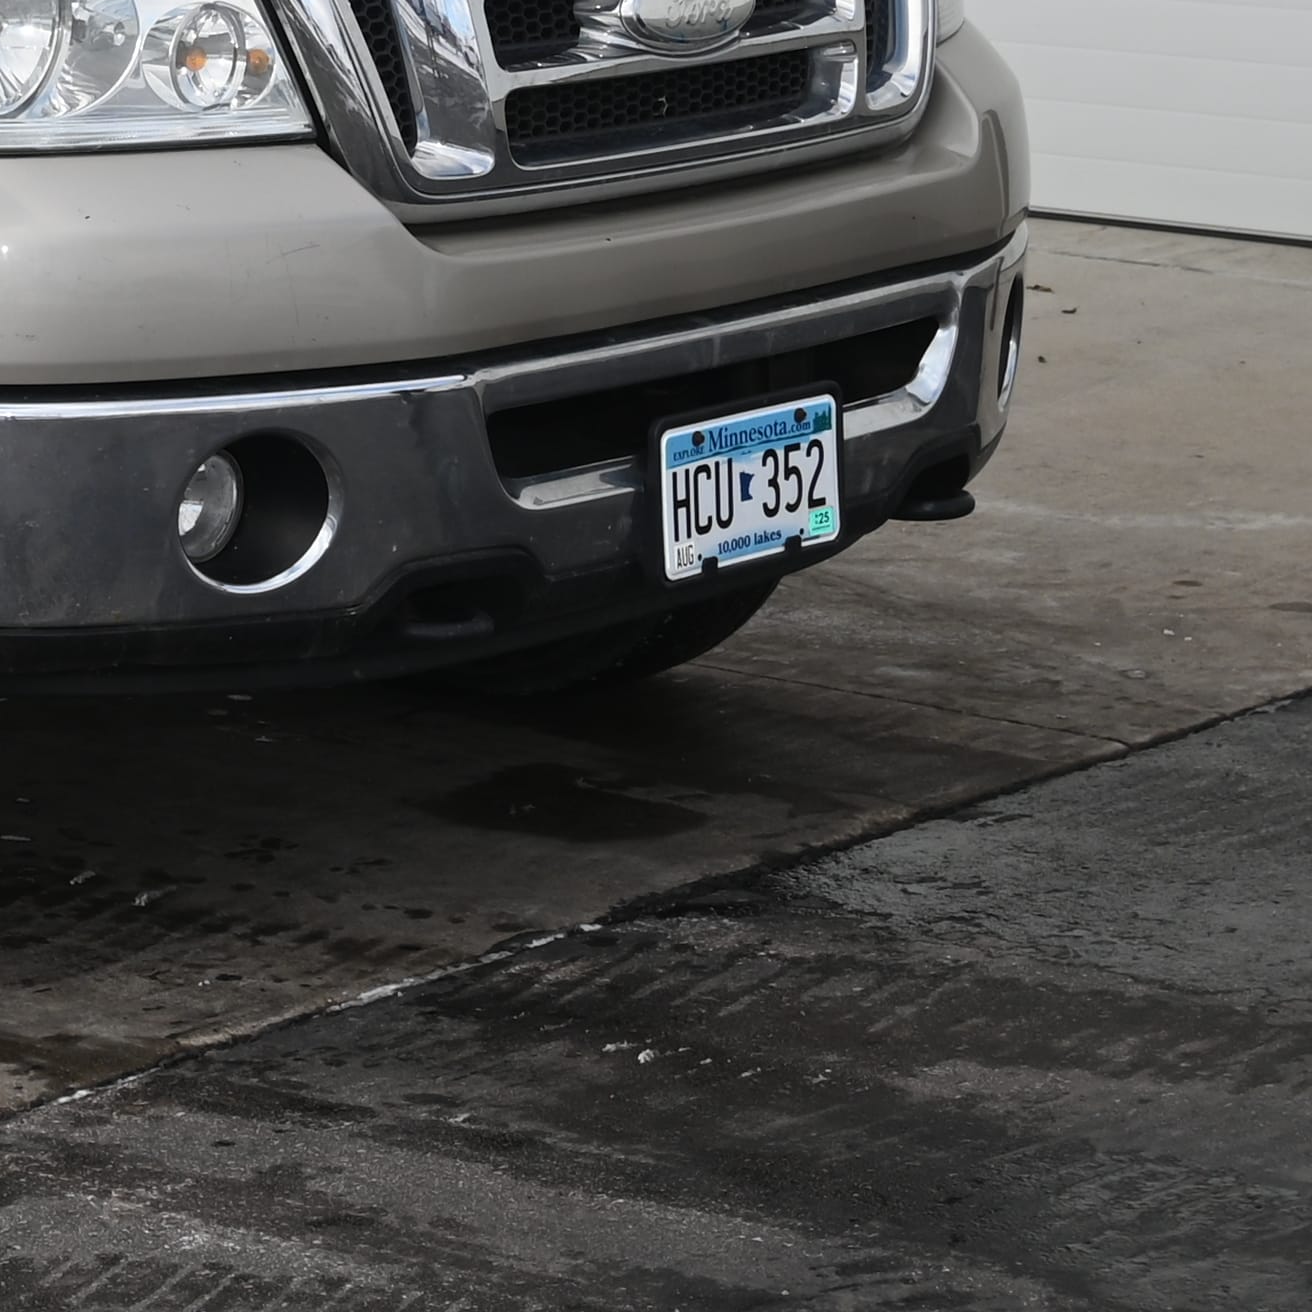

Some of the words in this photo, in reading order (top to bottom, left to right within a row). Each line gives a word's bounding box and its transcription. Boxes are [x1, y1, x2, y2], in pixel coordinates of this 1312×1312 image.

[672, 457, 734, 542] HCU
[762, 439, 827, 518] 352
[718, 534, 751, 555] 10,000
[754, 529, 782, 545] lakes
[677, 545, 694, 568] AUG
